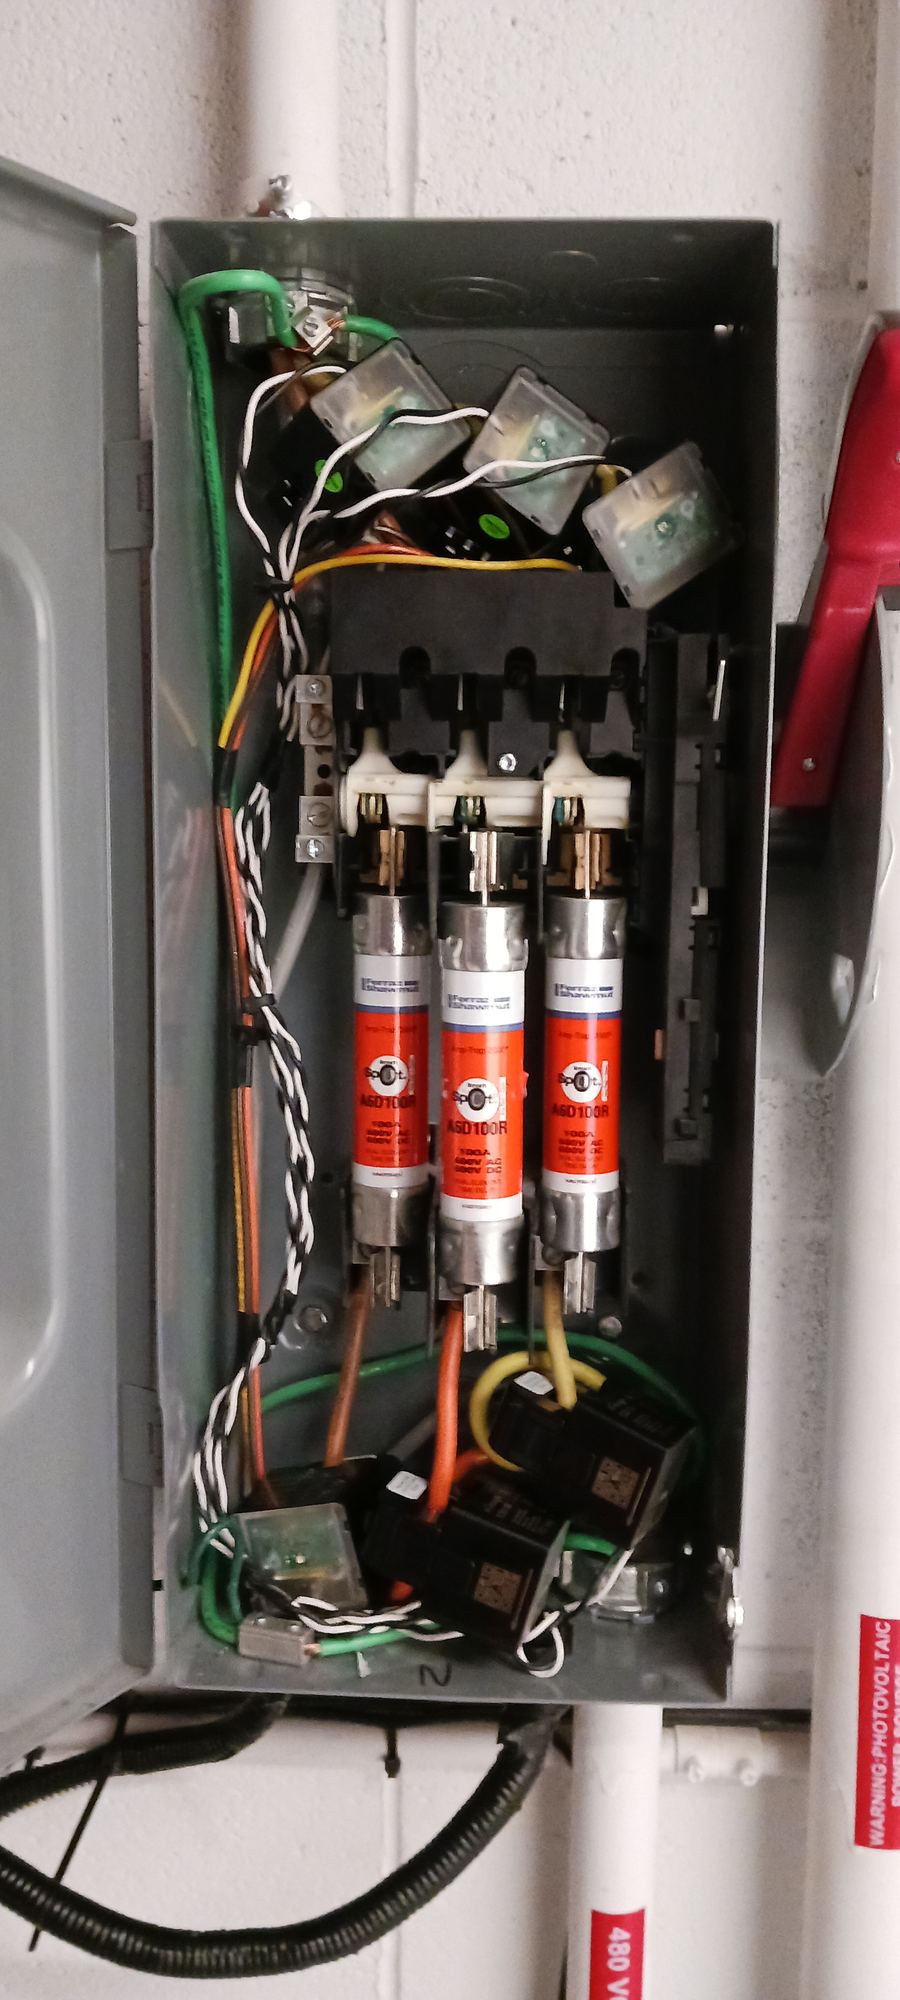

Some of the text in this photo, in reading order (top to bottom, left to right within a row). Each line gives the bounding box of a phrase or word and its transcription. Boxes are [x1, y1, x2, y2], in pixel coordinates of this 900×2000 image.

[447, 1120, 508, 1135] A6D100R
[607, 1927, 631, 2000] 480 V
